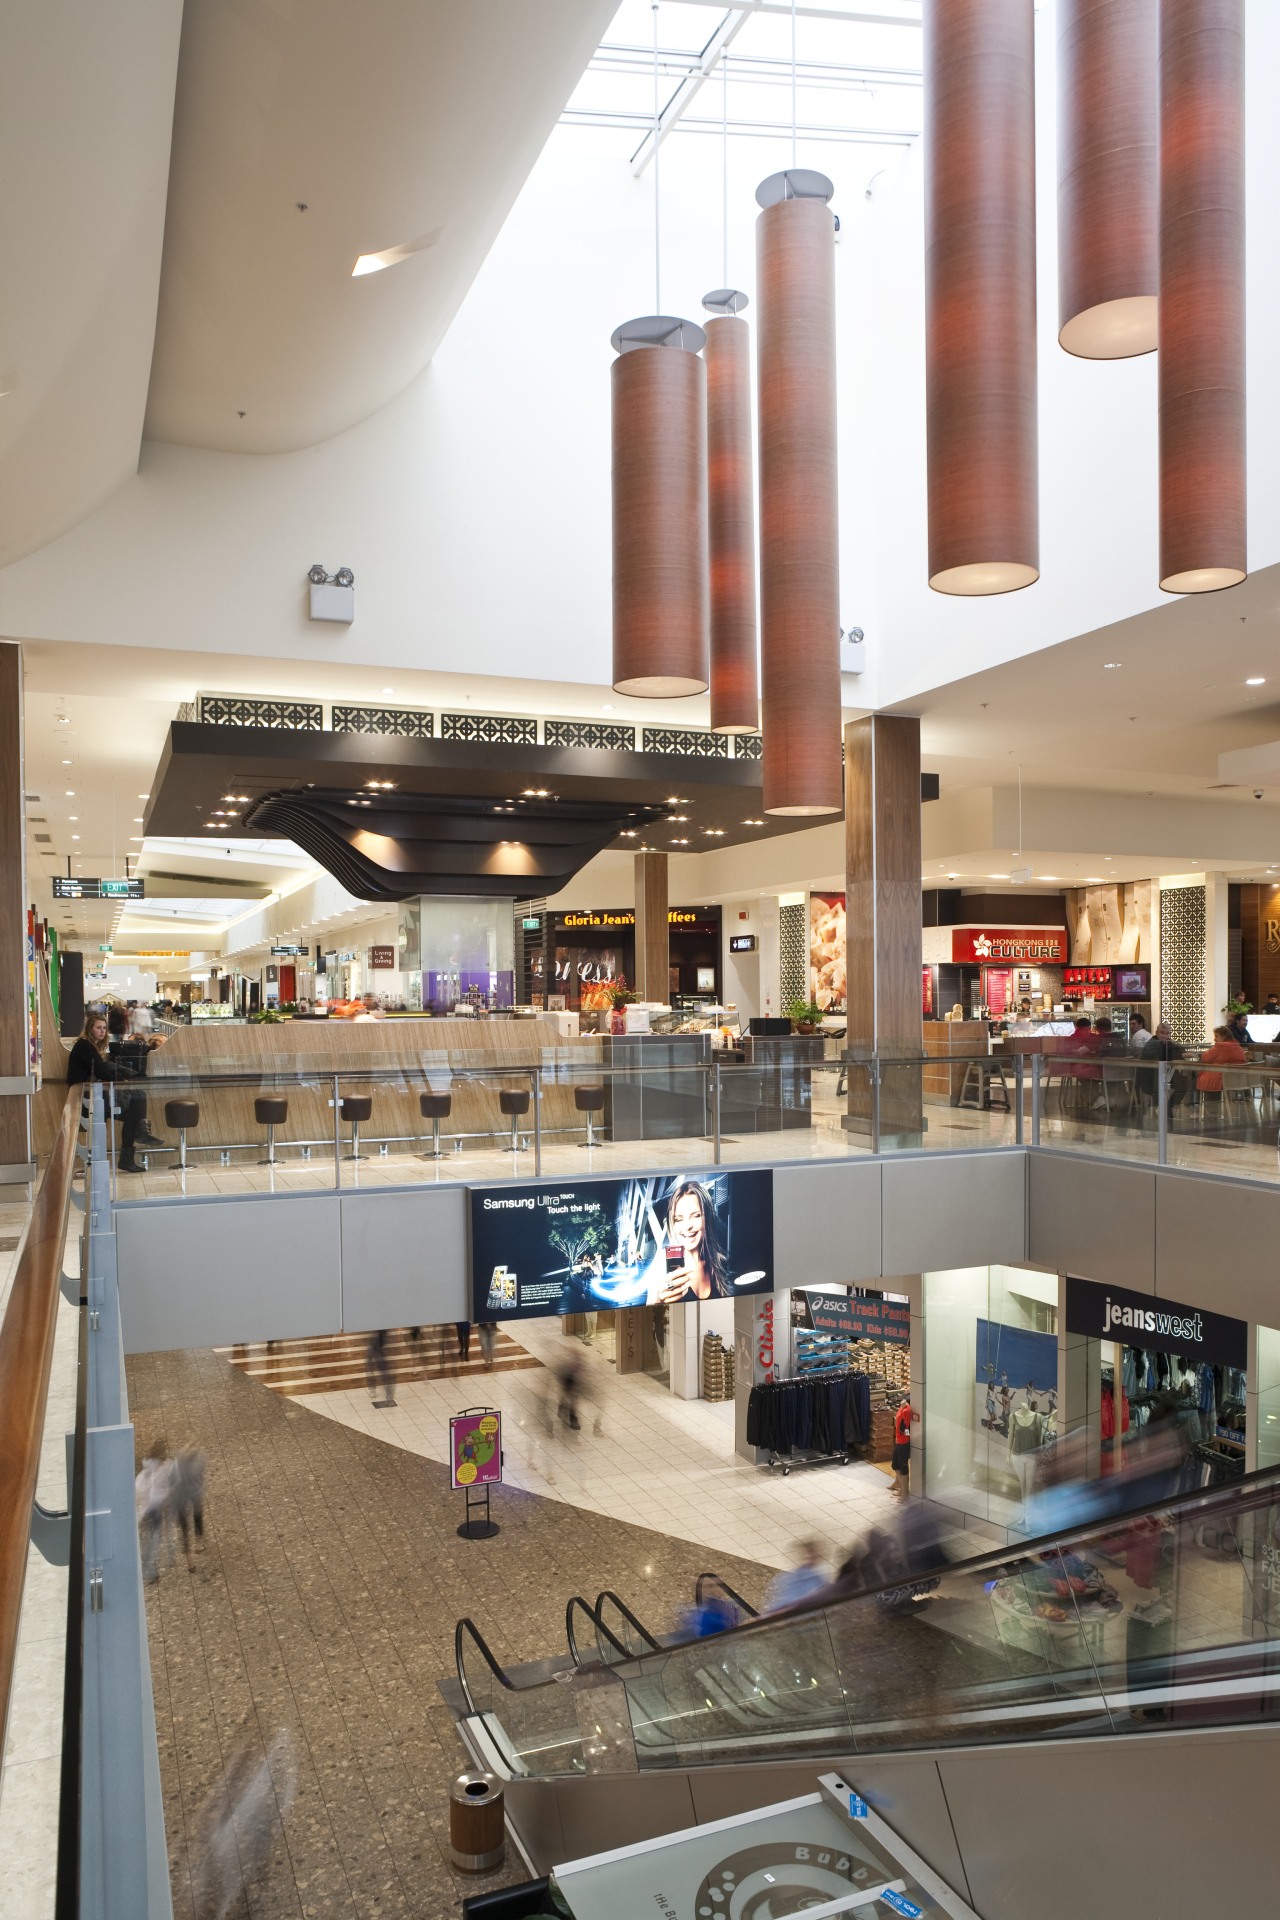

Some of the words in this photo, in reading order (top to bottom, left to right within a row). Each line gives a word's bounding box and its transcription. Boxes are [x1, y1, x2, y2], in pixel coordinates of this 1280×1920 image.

[107, 884, 122, 892] EXIT
[564, 914, 601, 926] Gloria
[602, 913, 635, 926] Jean's
[668, 911, 696, 923] ffees
[992, 938, 1044, 946] HONGKONG
[990, 945, 1061, 958] CULTURE
[483, 1198, 535, 1210] Samsung
[537, 1195, 560, 1207] Ultra
[547, 1205, 569, 1214] Touch
[570, 1204, 583, 1213] the
[584, 1203, 601, 1213] light
[822, 1300, 848, 1313] asics
[849, 1300, 880, 1317] Track
[1102, 1297, 1203, 1342] jeanswest
[759, 1298, 774, 1369] Clinic
[866, 1323, 882, 1335] Kids
[1229, 1431, 1241, 1441] OFF
